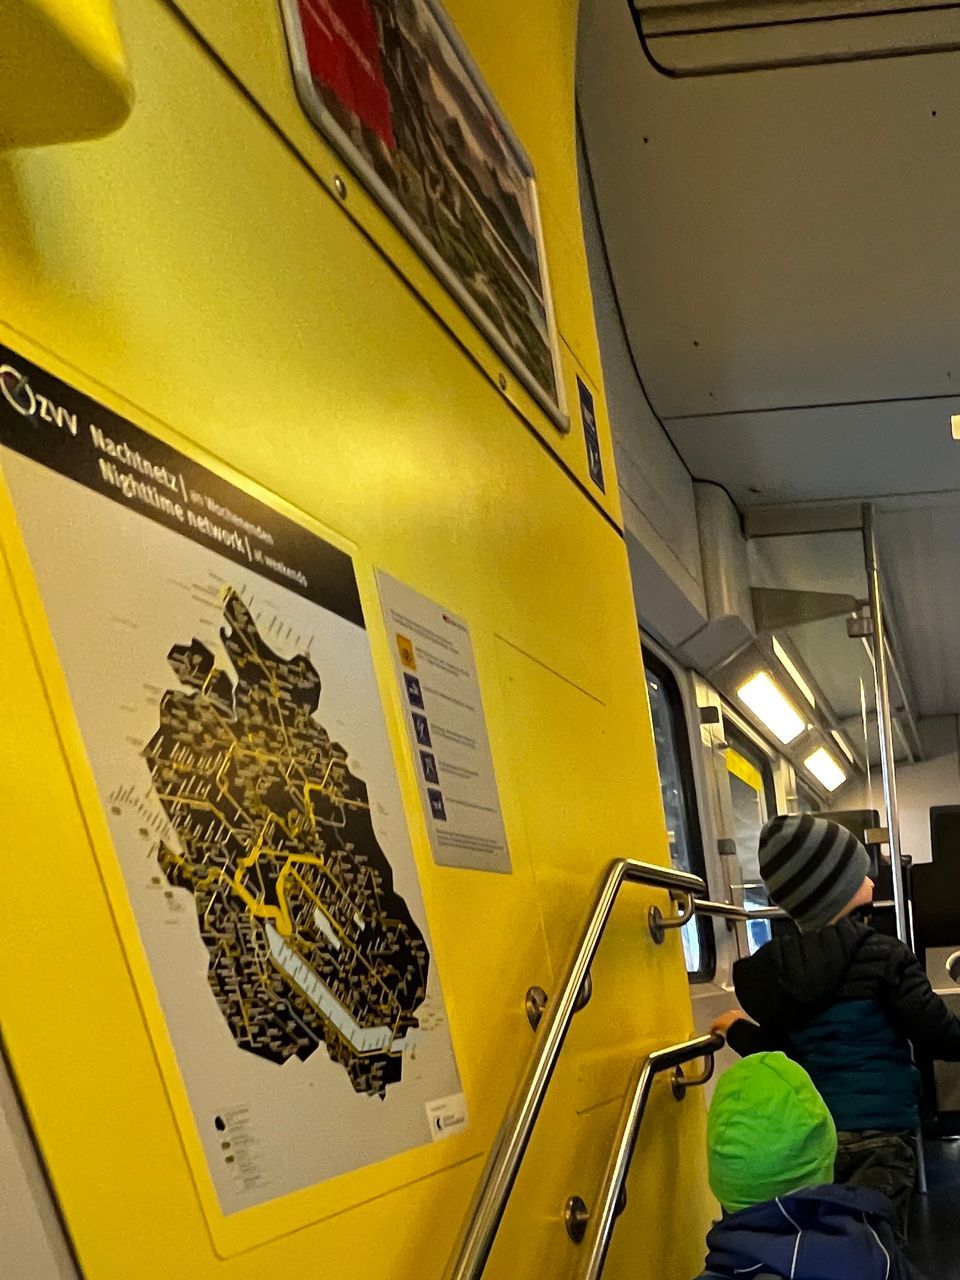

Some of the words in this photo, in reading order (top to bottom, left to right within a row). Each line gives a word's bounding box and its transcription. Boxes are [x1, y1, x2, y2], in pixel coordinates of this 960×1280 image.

[36, 393, 78, 437] ZVV
[89, 423, 179, 493] Nachtnetz
[98, 457, 185, 522] Nighttime
[187, 509, 246, 554] network
